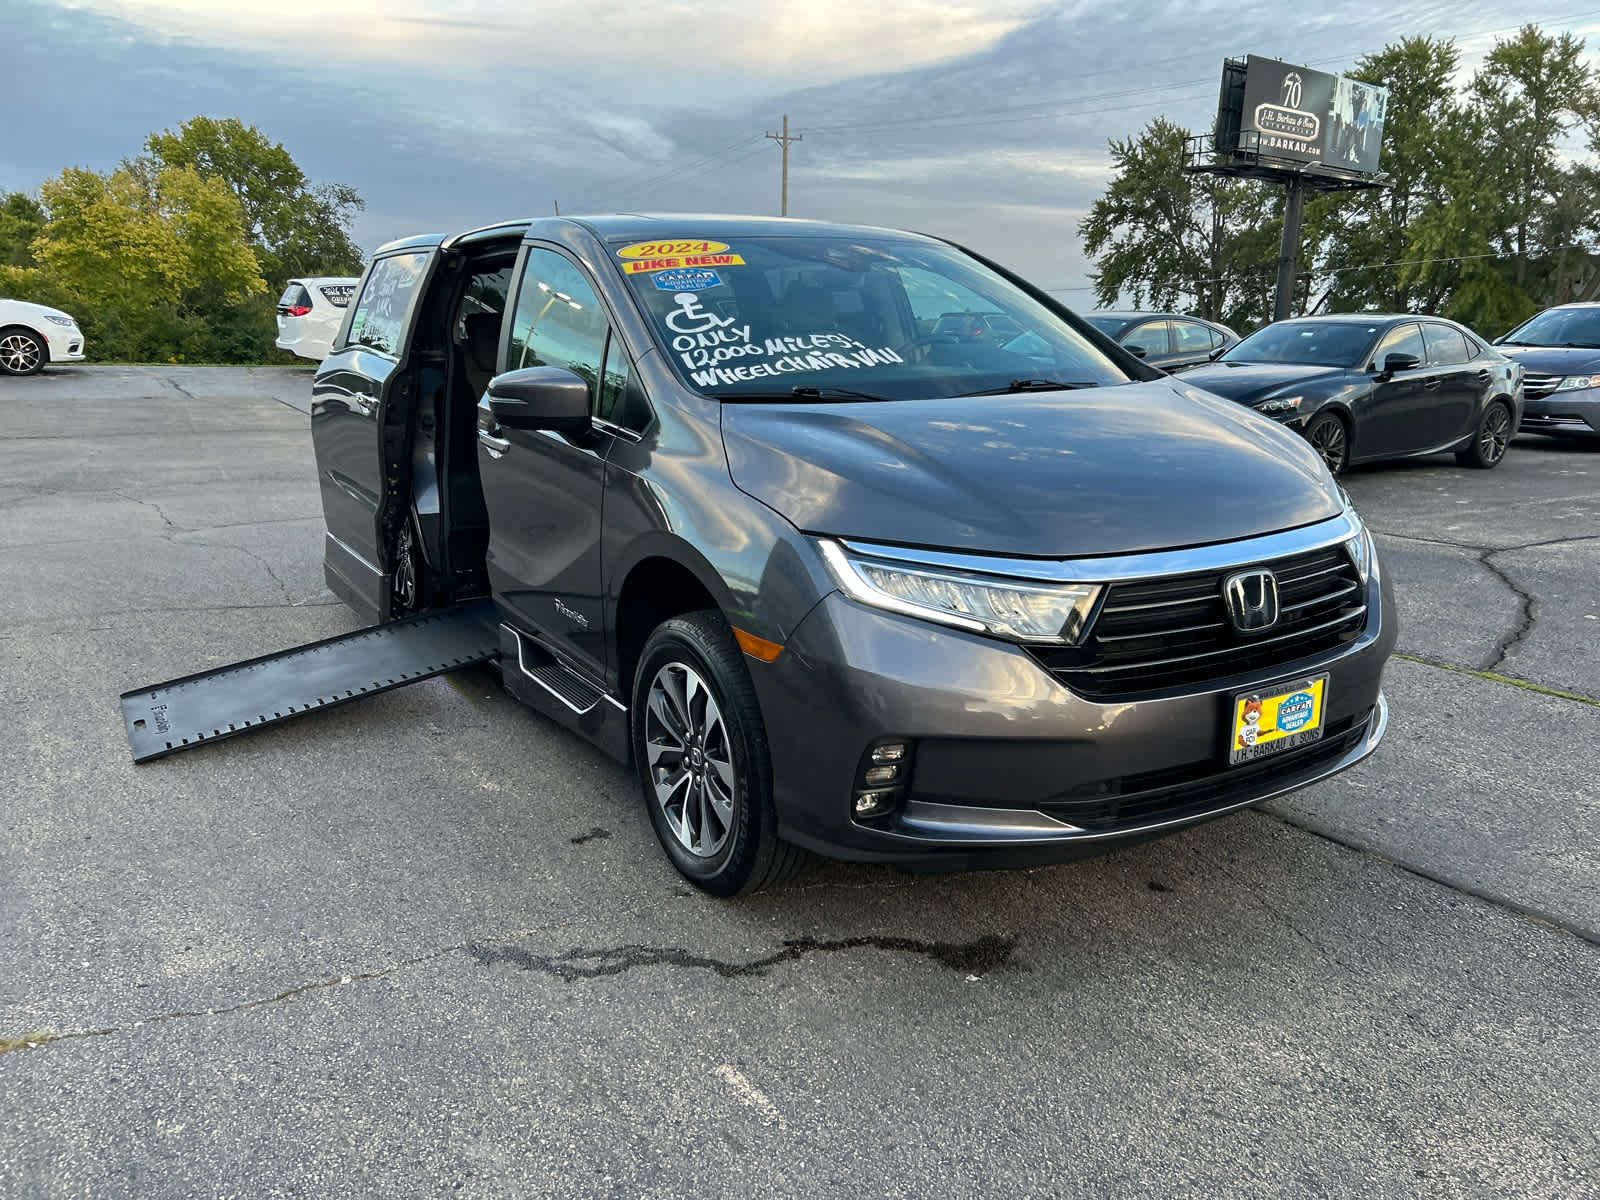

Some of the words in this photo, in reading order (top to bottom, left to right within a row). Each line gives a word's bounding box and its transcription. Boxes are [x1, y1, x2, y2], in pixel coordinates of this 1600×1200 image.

[1283, 79, 1302, 109] 70
[639, 242, 711, 256] 2024
[632, 258, 680, 271] LIKE
[672, 325, 750, 351] ONLY
[690, 351, 855, 387] WHEELCHAIR
[1286, 719, 1304, 730] DEALER
[1254, 738, 1286, 757] BARKAU
[1290, 737, 1296, 746] &
[1300, 729, 1319, 743] SONS
